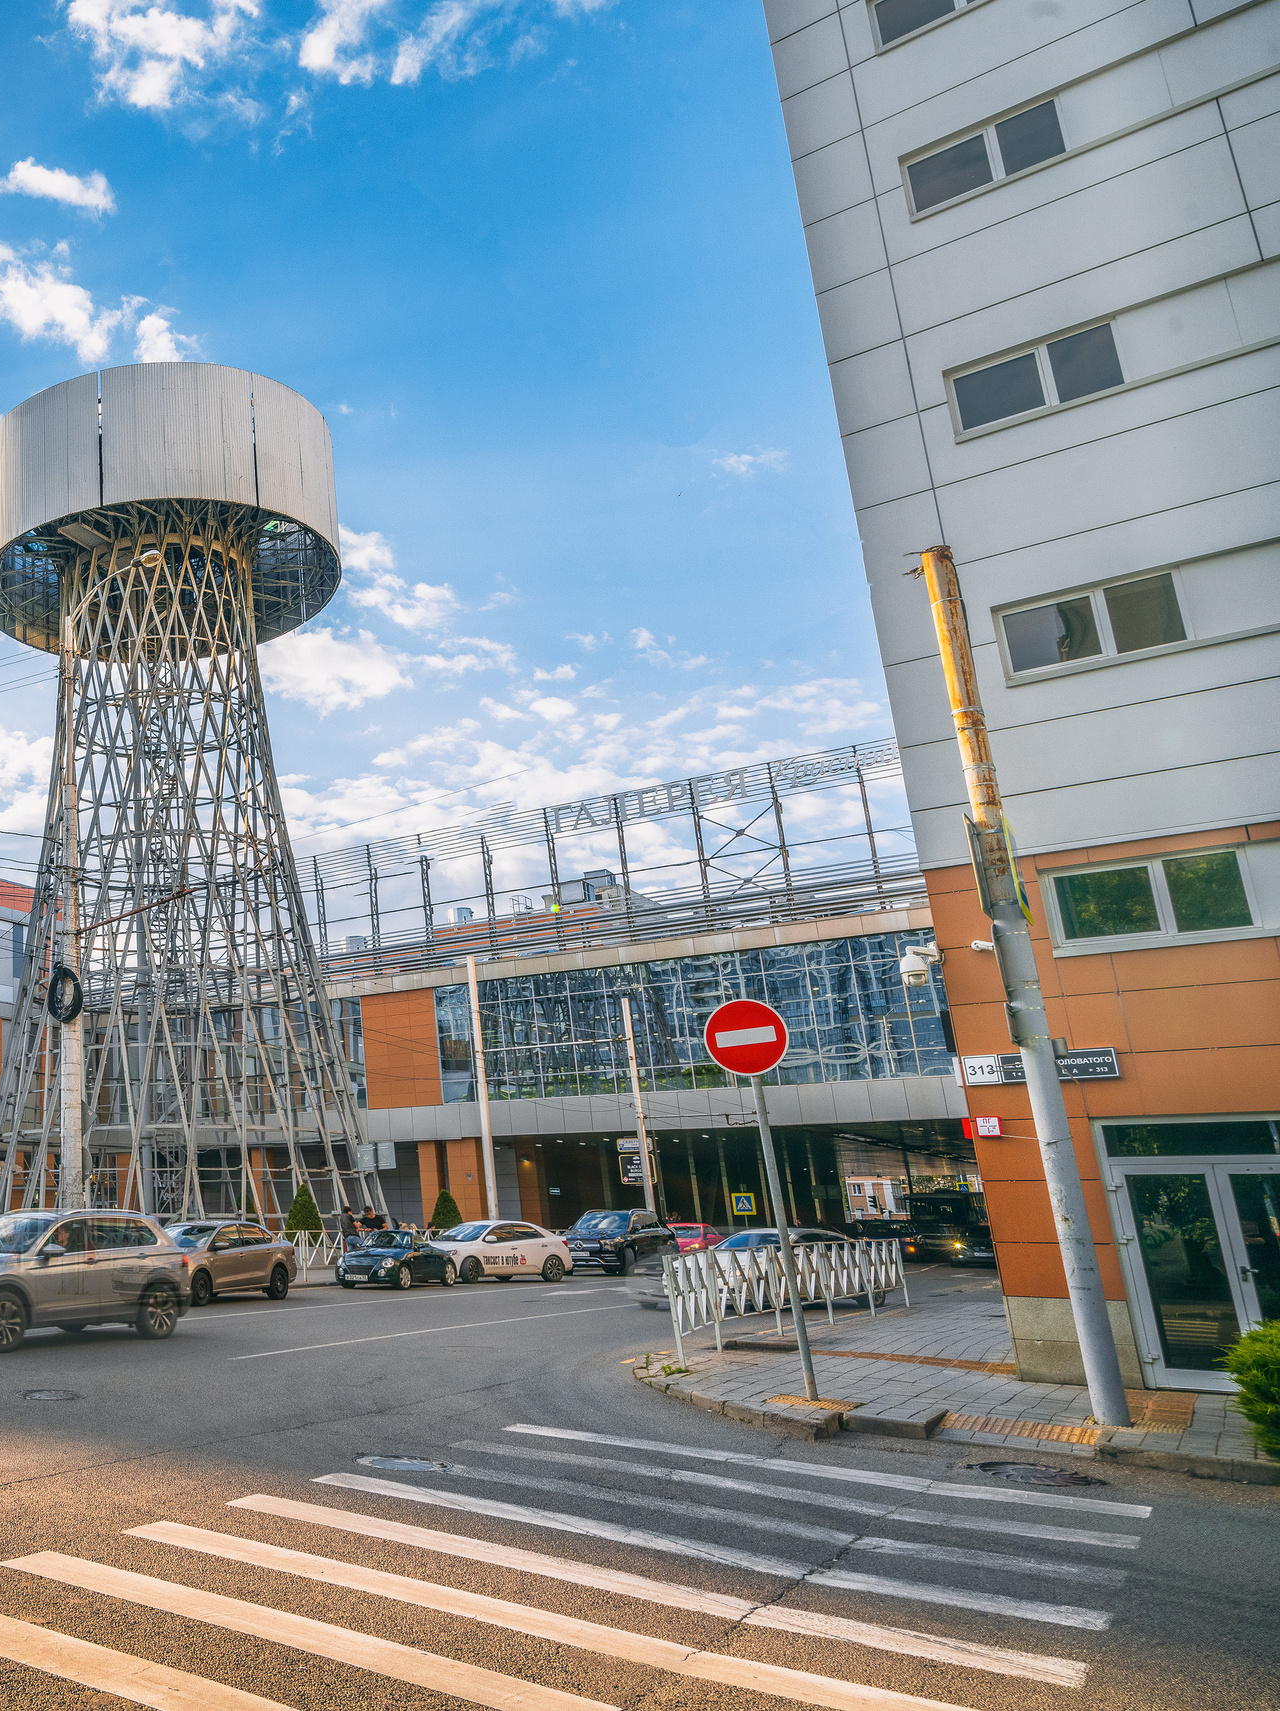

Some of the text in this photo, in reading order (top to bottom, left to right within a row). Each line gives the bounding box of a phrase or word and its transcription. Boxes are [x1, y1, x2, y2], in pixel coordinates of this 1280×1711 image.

[552, 769, 748, 833] ГАЛЕРЕЯ
[1056, 1056, 1112, 1066] ОЛОВАТОГО
[968, 1064, 995, 1076] 313
